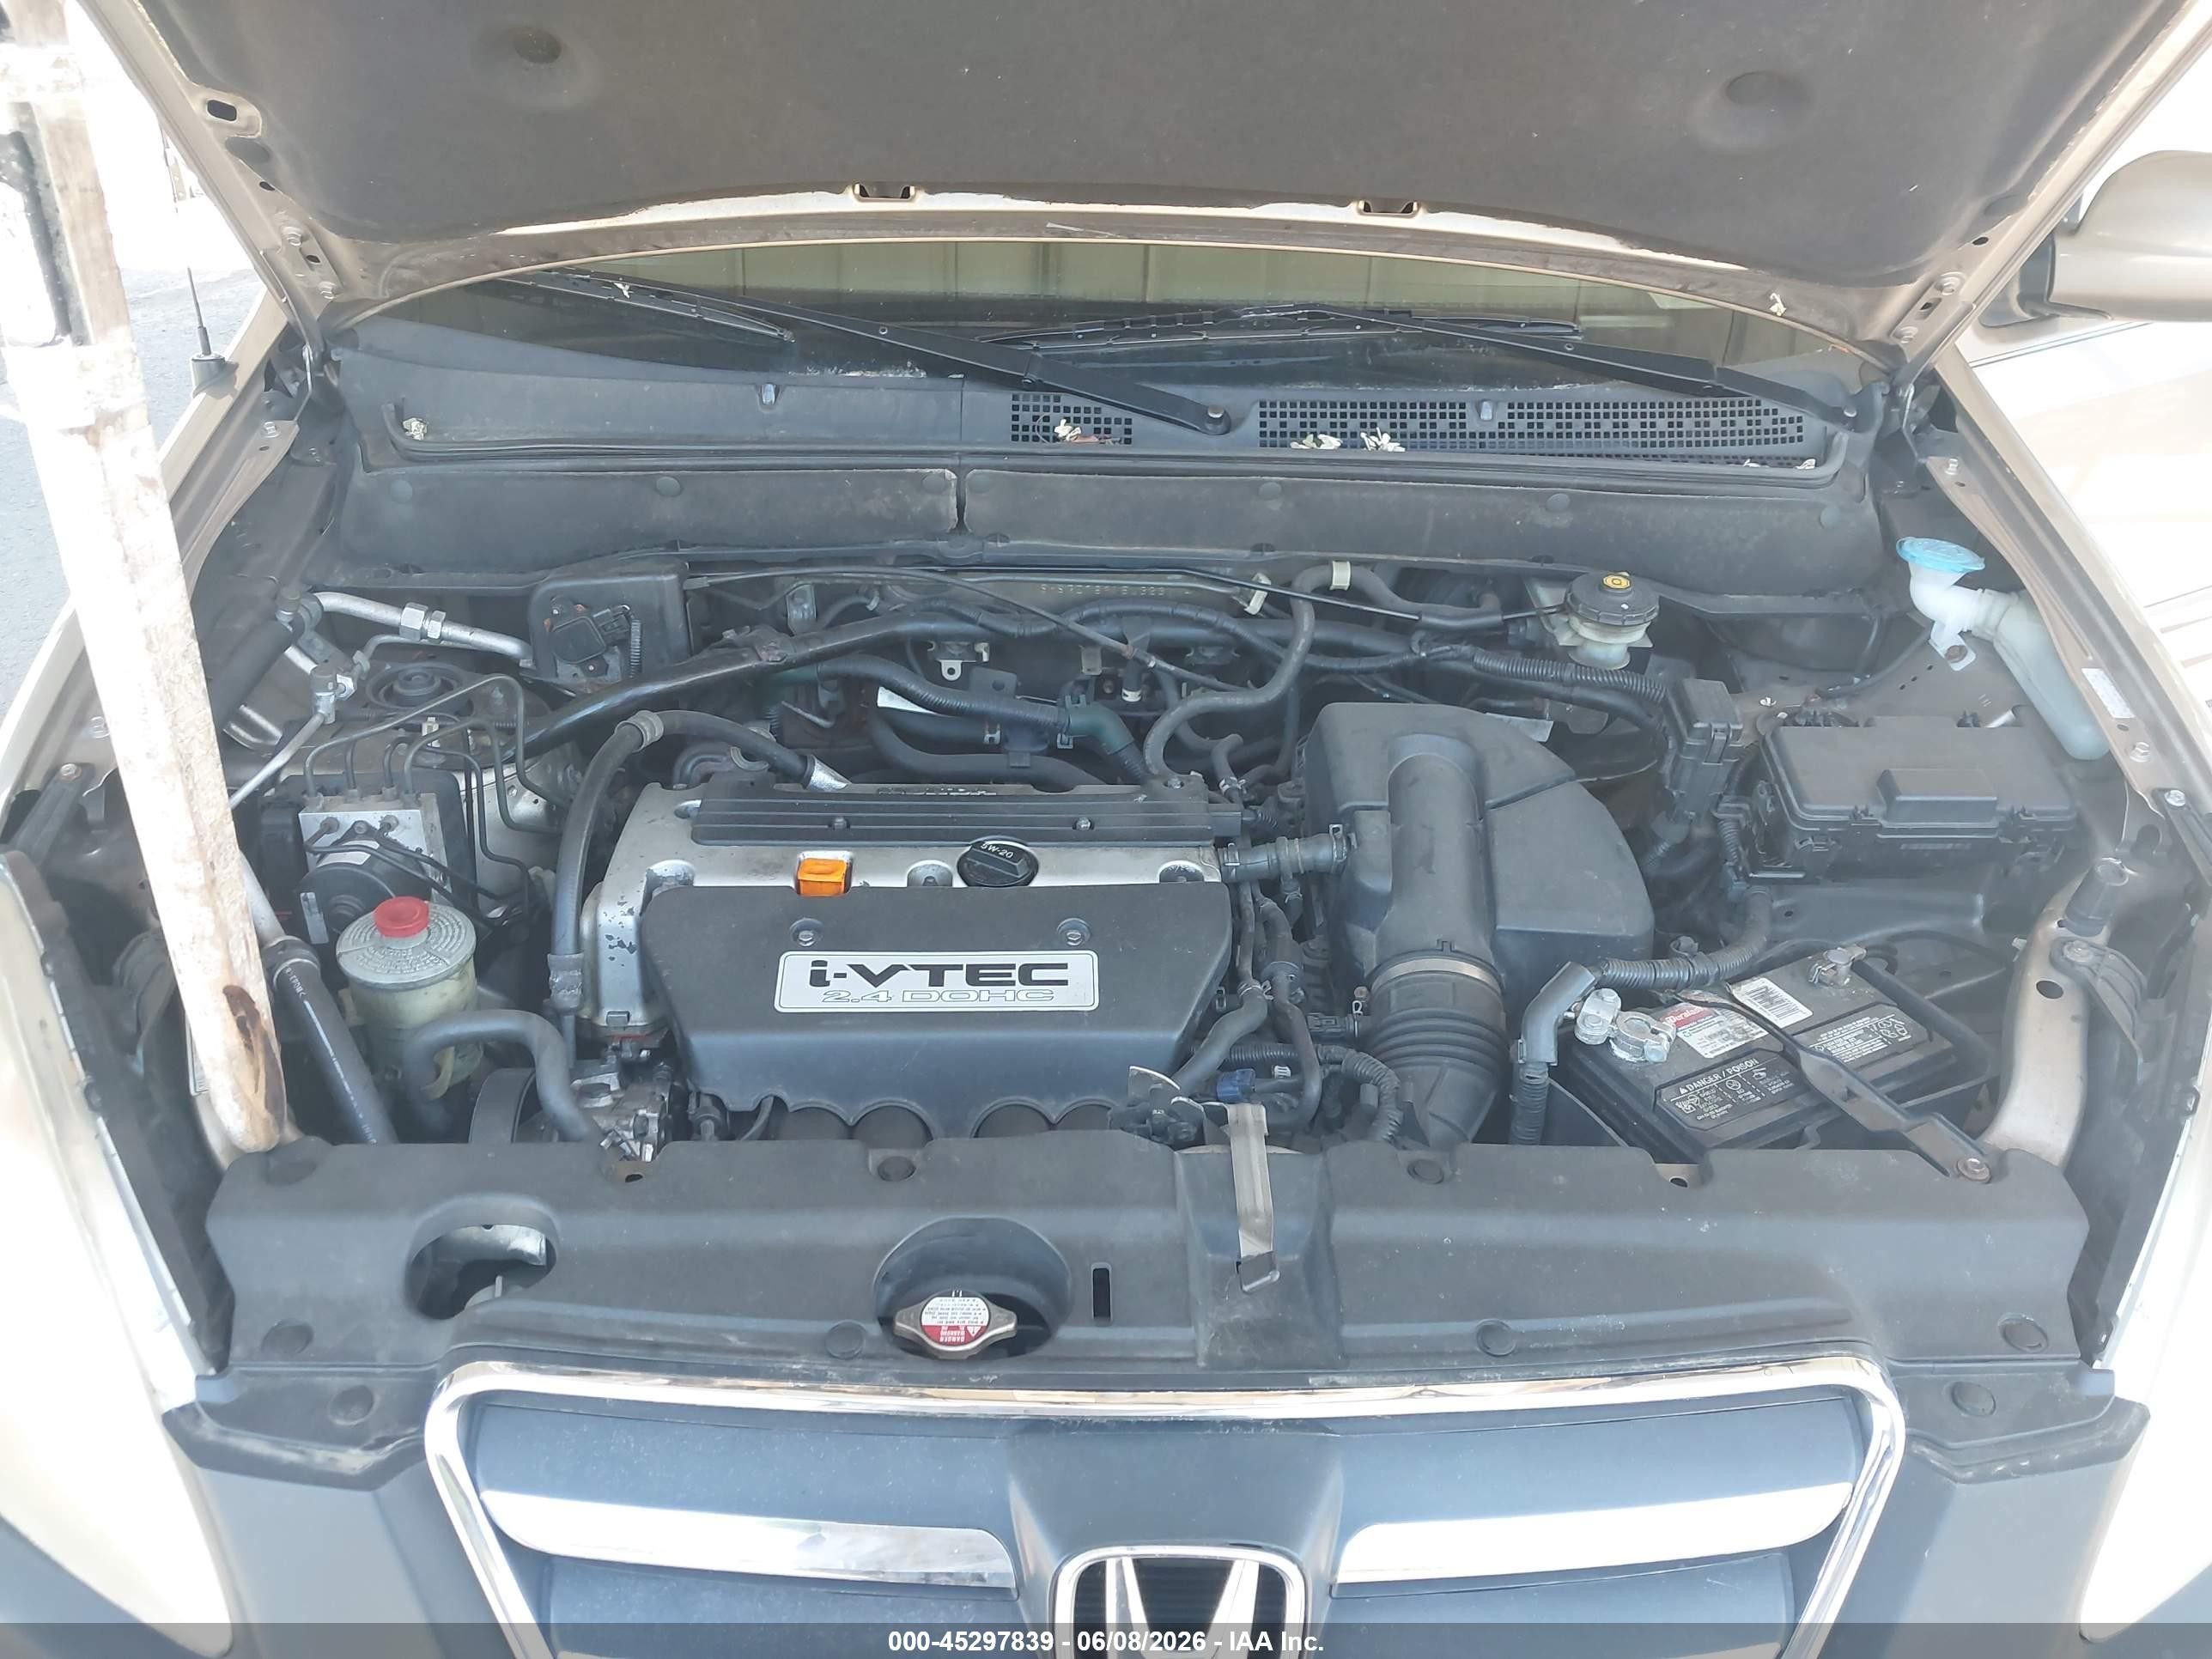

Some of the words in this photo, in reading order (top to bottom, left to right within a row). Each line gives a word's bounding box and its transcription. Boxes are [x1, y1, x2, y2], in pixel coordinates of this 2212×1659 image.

[980, 842, 1014, 859] 5W-20
[809, 959, 1069, 988] i-VTEC
[822, 990, 892, 1003] 2.4
[902, 989, 1054, 1003] DOHC
[1686, 1073, 1723, 1091] DANGER
[1728, 1058, 1760, 1075] POISON
